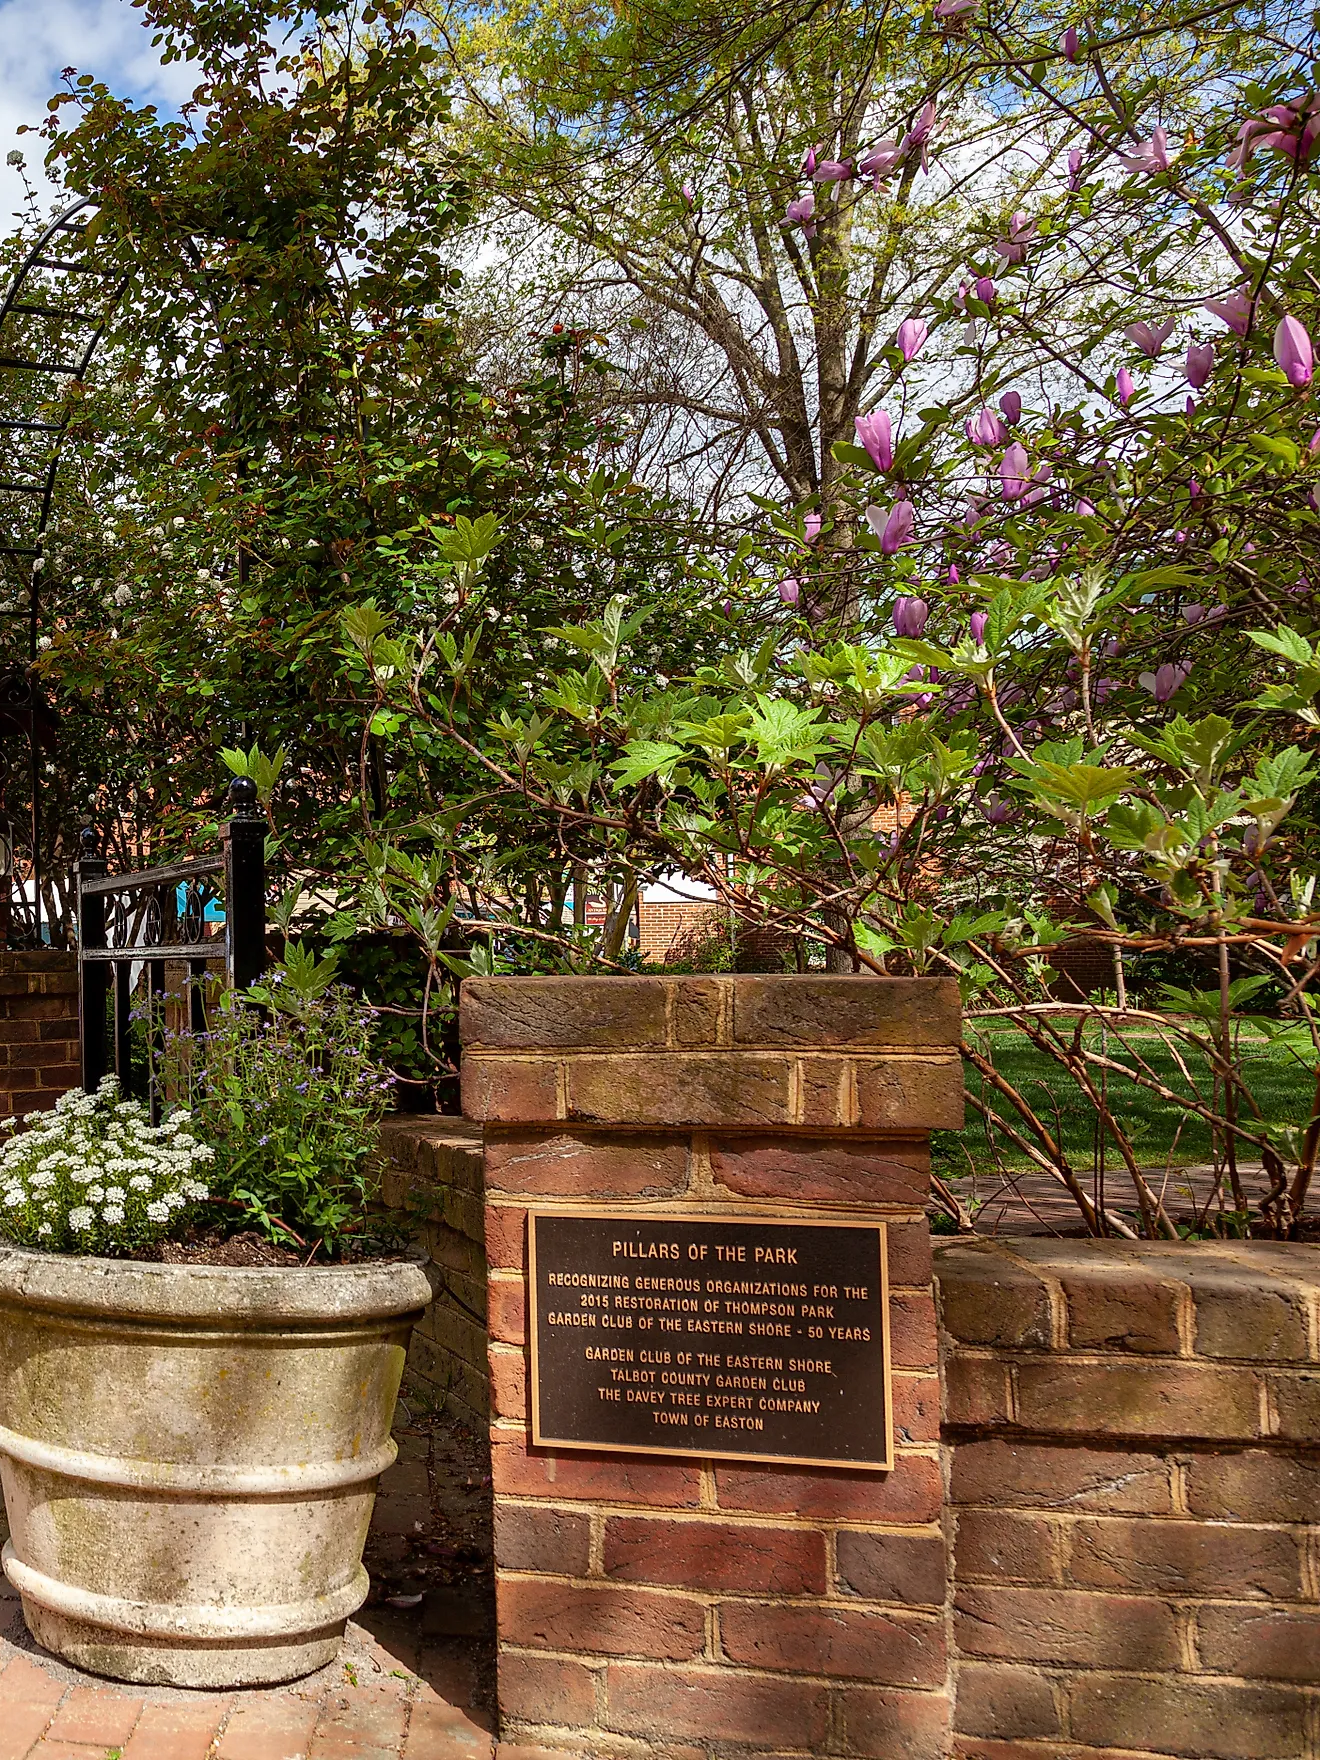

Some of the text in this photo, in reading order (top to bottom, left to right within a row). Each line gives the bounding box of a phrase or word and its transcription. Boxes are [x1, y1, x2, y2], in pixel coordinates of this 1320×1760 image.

[612, 1240, 798, 1265] PILLARS OF THE PARK
[548, 1272, 868, 1300] RECOGNIZING GENEROUS ORGANIZATIONS FOR THE
[580, 1293, 835, 1319] 2015 RESTORATION OF THOMPSON PARK
[547, 1311, 597, 1328] GARDEN
[601, 1313, 633, 1329] CLUB
[638, 1316, 654, 1330] OF
[658, 1316, 682, 1332] THE
[687, 1318, 743, 1335] EASTERN
[748, 1322, 792, 1337] SHORE
[807, 1326, 824, 1339] 50
[828, 1326, 871, 1342] YEARS
[585, 1345, 832, 1373] GARDEN CLUB OF THE EASTERN SHORE
[610, 1367, 806, 1394] TALBOT COUNTY GARDEN CLUB
[597, 1387, 821, 1414] THE DAVEY TREE EXPERT COMPANY
[652, 1411, 764, 1431] TOWN OF EASTON
